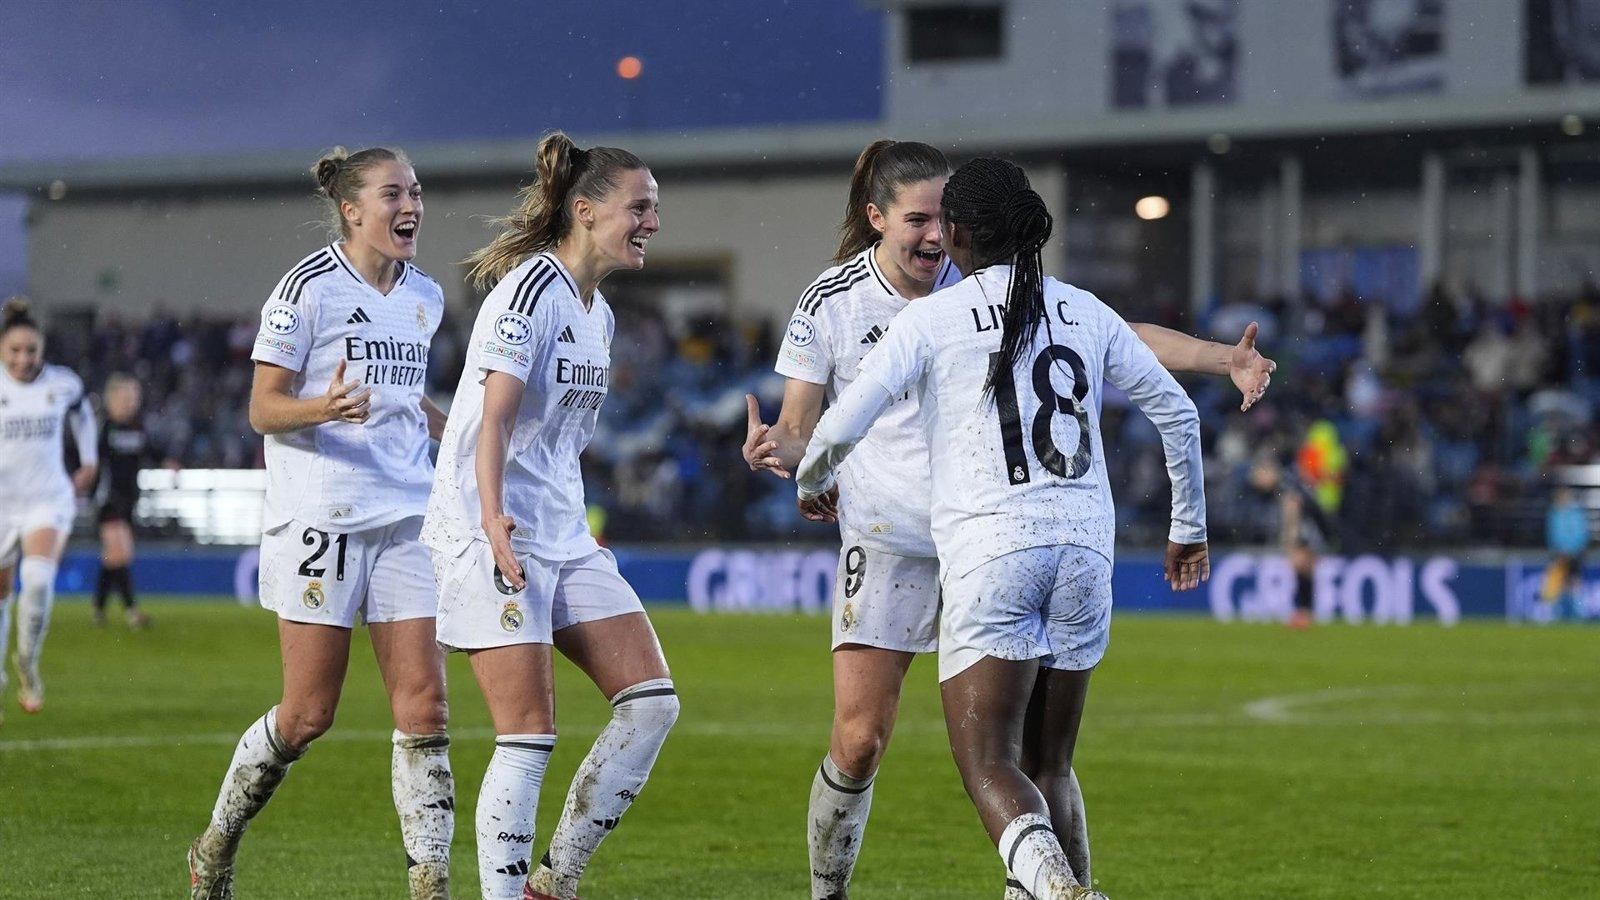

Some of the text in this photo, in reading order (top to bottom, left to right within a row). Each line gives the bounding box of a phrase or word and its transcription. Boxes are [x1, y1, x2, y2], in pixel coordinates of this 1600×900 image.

[971, 299, 1080, 333] LINA C.
[344, 335, 429, 365] Emirate
[364, 364, 388, 385] FLY
[557, 388, 583, 407] FLY
[985, 343, 1092, 487] 18
[297, 526, 348, 581] 21
[844, 545, 867, 599] 9
[1208, 552, 1461, 627] GRFOLS
[497, 831, 535, 844] RMC
